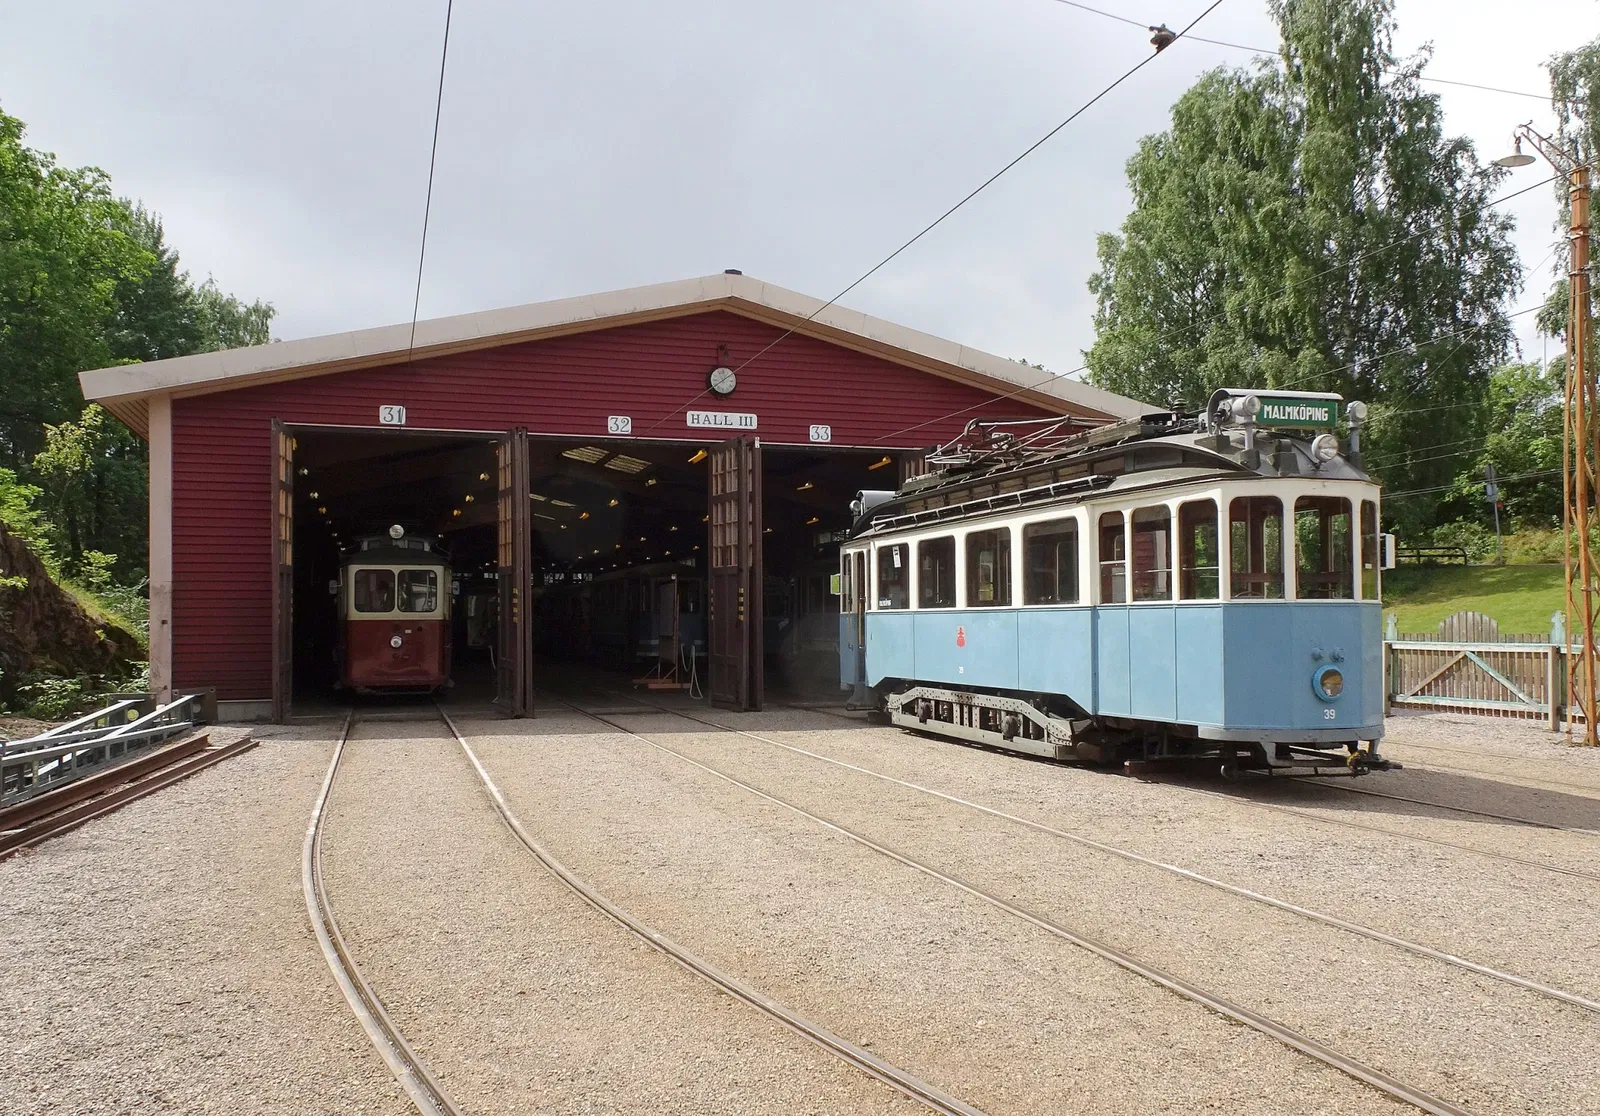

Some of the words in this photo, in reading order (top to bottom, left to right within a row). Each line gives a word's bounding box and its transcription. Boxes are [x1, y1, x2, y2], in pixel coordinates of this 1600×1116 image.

[383, 406, 402, 423] 31
[1263, 404, 1328, 421] MALMKÖPING
[610, 417, 630, 432] 32
[691, 414, 733, 426] HALL
[739, 416, 753, 426] III
[811, 426, 829, 440] 33
[1324, 709, 1335, 720] 39
